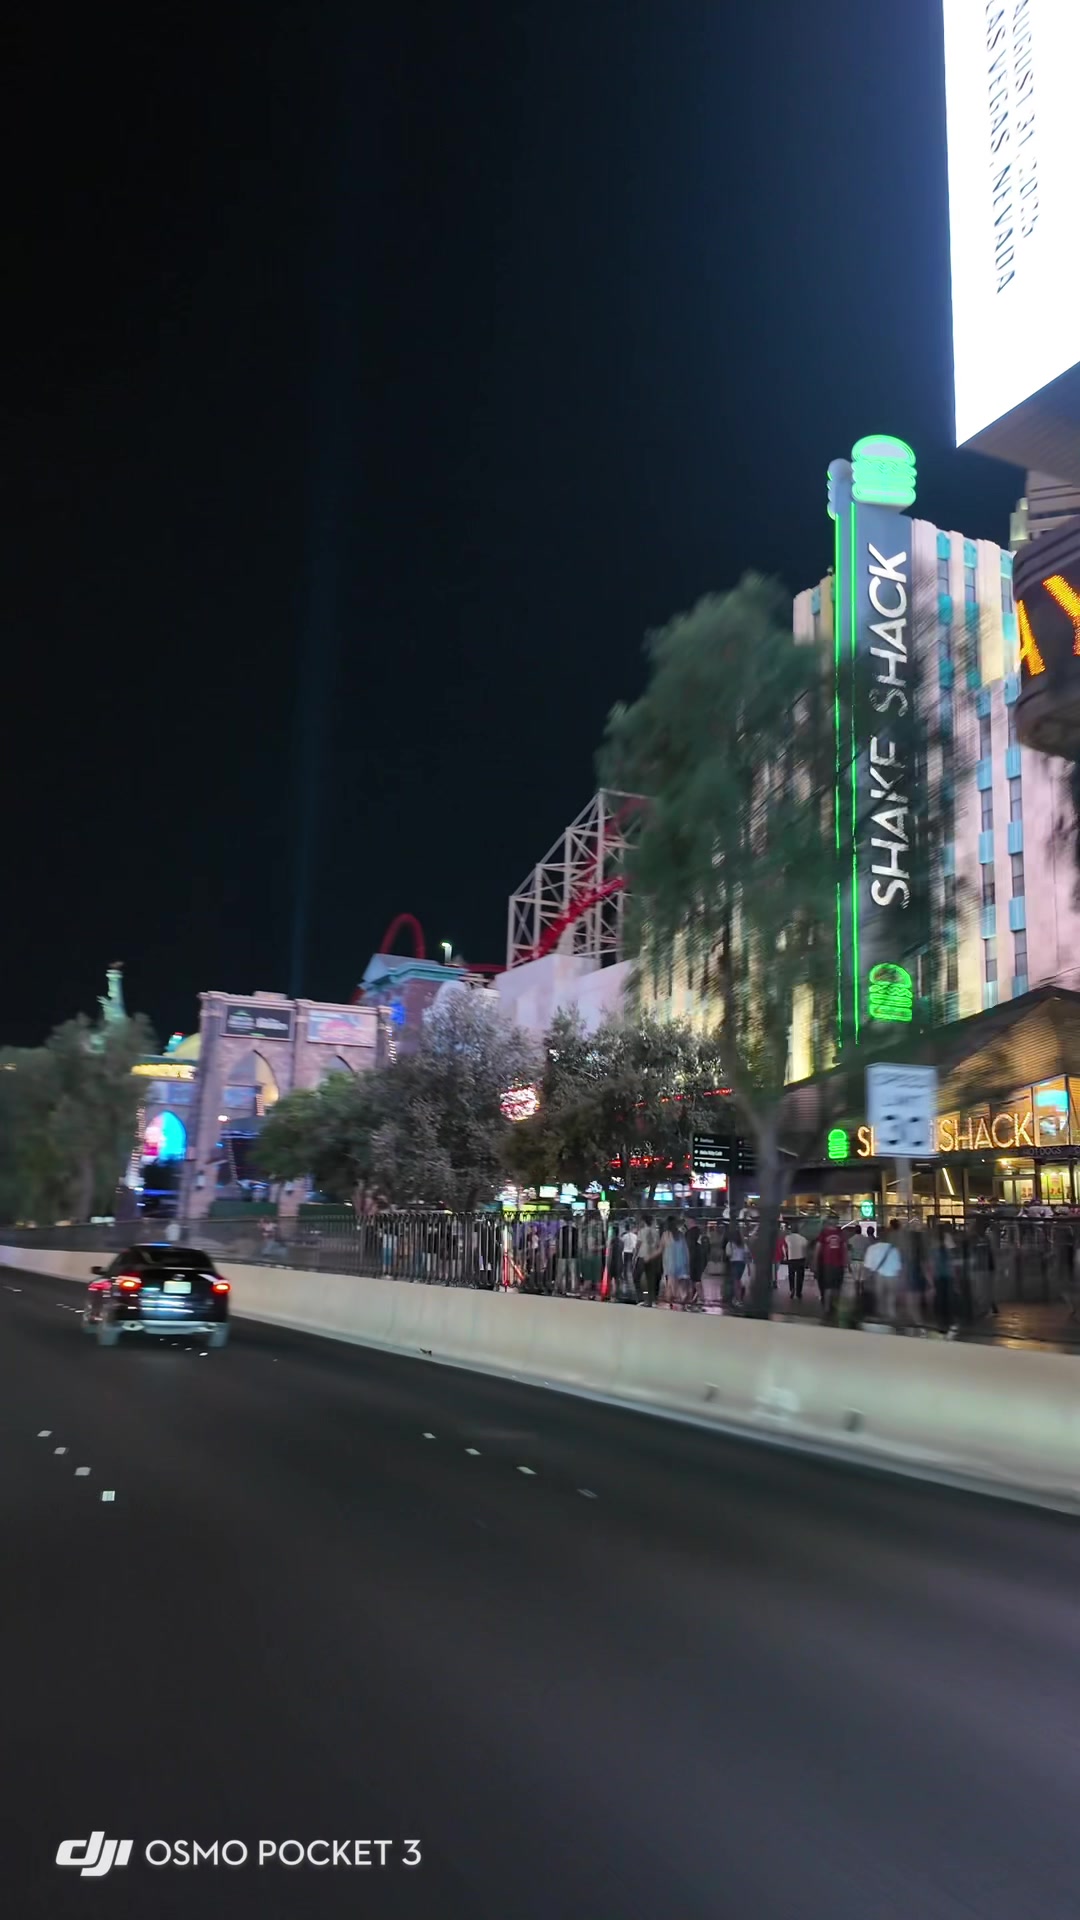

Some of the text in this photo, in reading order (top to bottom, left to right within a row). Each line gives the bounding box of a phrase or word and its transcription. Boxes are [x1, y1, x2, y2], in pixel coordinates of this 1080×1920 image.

[992, 162, 1016, 295] NEVADA
[867, 543, 910, 909] SHAKE SHACK
[938, 1111, 1035, 1152] SHACK
